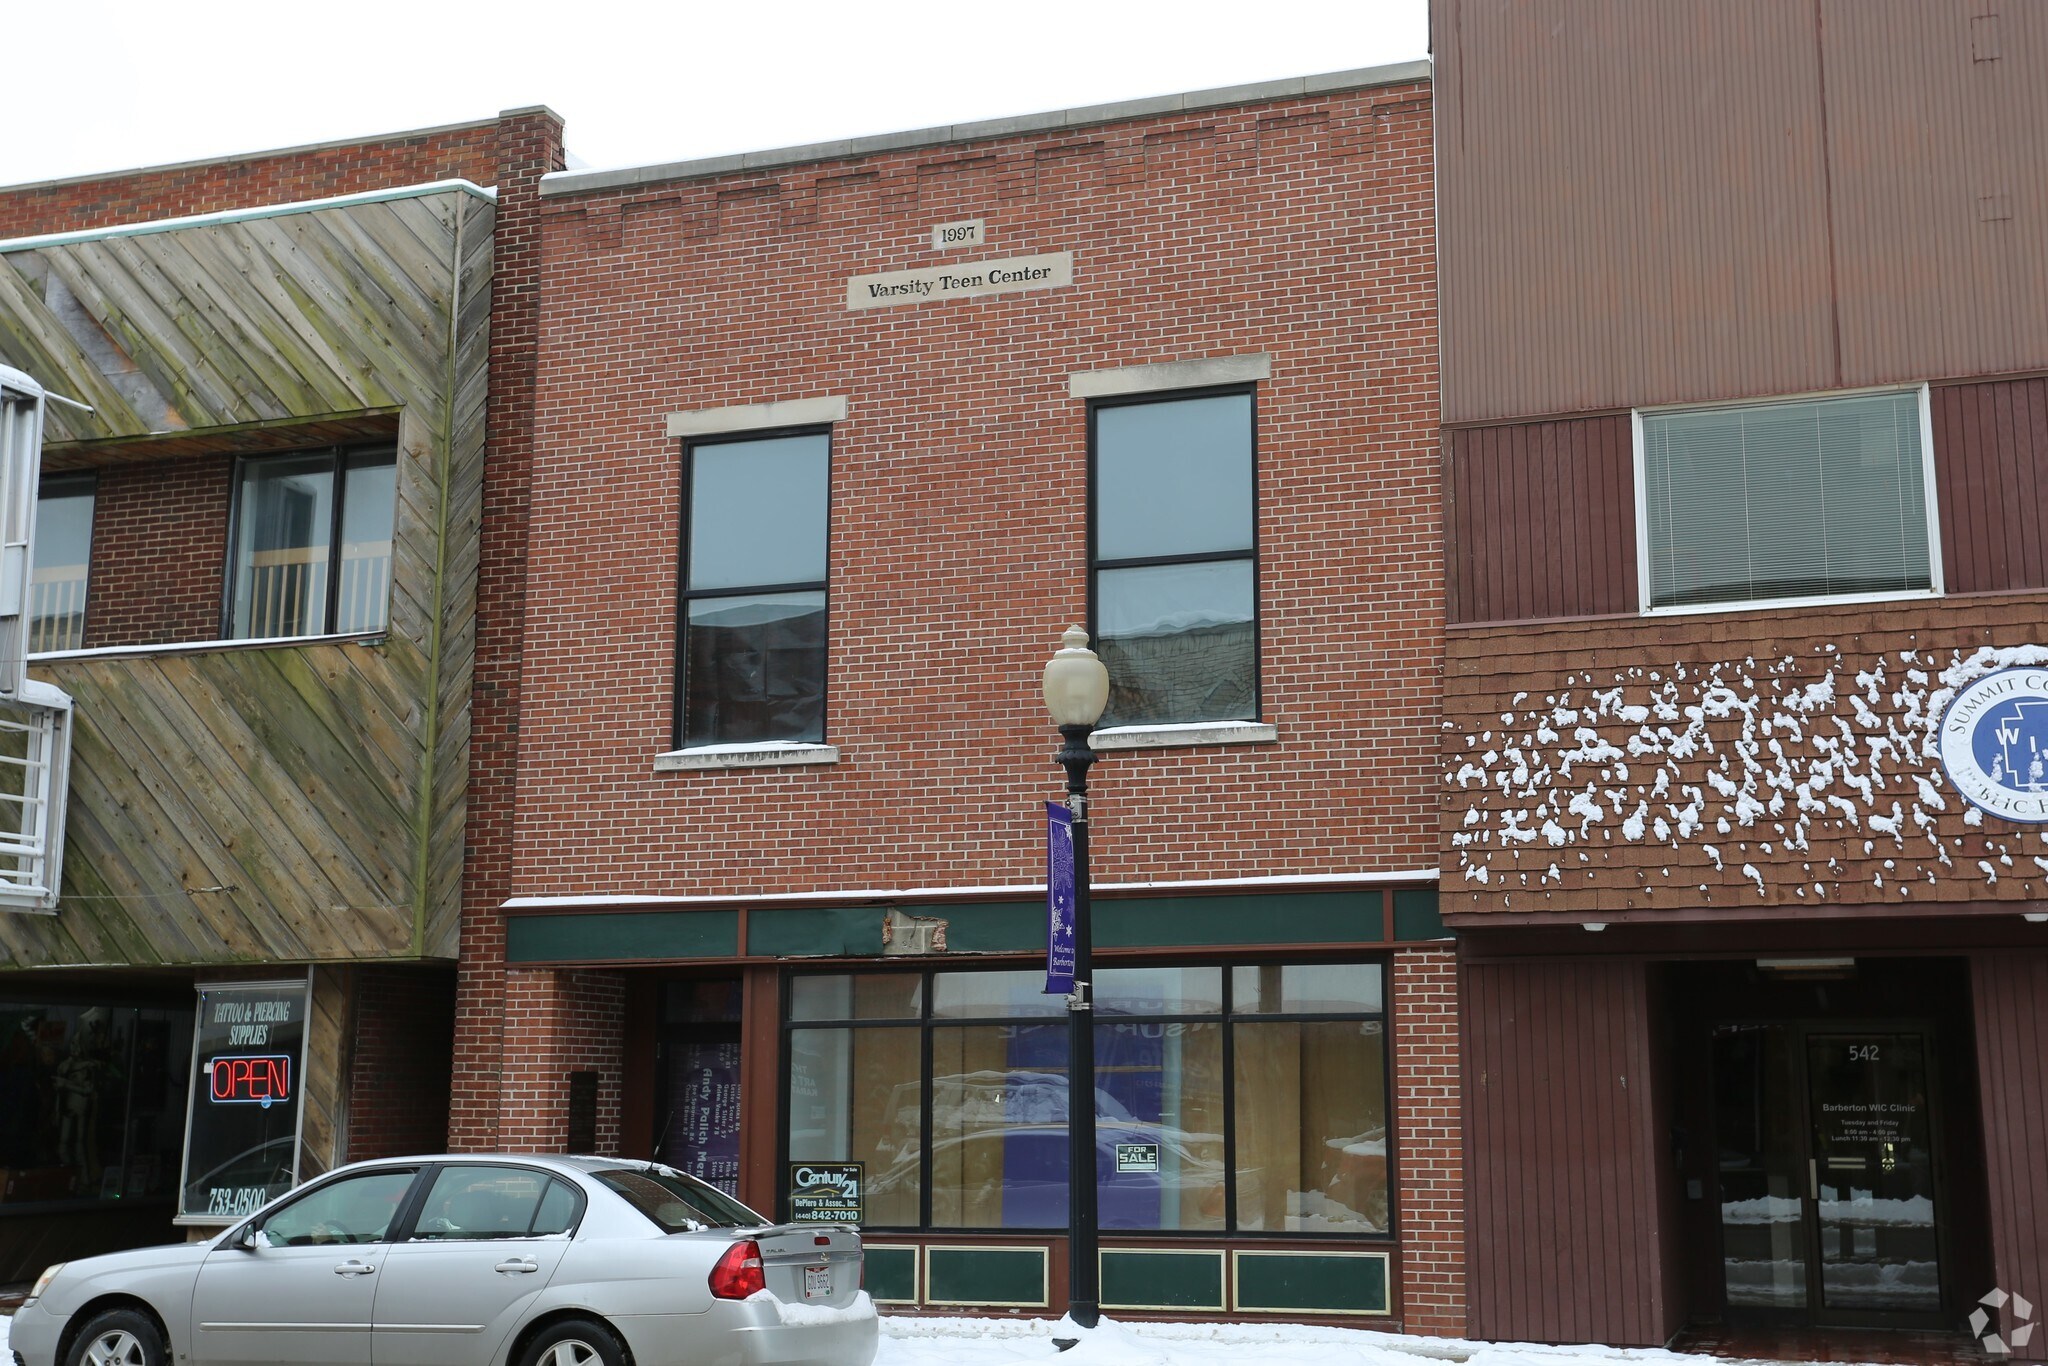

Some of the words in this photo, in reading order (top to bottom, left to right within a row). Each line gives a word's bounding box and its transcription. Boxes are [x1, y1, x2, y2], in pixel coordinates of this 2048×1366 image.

[941, 226, 976, 243] 1997
[868, 279, 934, 298] Varsity
[939, 275, 983, 290] Teen
[988, 266, 1051, 285] Center
[1949, 678, 2016, 735] SUMMIT
[214, 1002, 245, 1023] TATTOO
[244, 1002, 252, 1023] &
[253, 1001, 291, 1022] PIERCING
[228, 1024, 269, 1046] SUPPLIES
[1849, 1045, 1880, 1061] 542
[213, 1059, 287, 1098] OPEN
[700, 1068, 712, 1100] Andy
[1822, 1104, 1867, 1112] Barberton
[1869, 1104, 1887, 1112] WIC
[1889, 1104, 1916, 1112] Clinic
[698, 1107, 710, 1144] Palich
[1120, 1153, 1155, 1163] SALE
[796, 1167, 848, 1188] Century
[842, 1180, 859, 1198] 21
[207, 1188, 266, 1215] 753-0500
[819, 1199, 823, 1207] &
[811, 1210, 858, 1220] 842-7010
